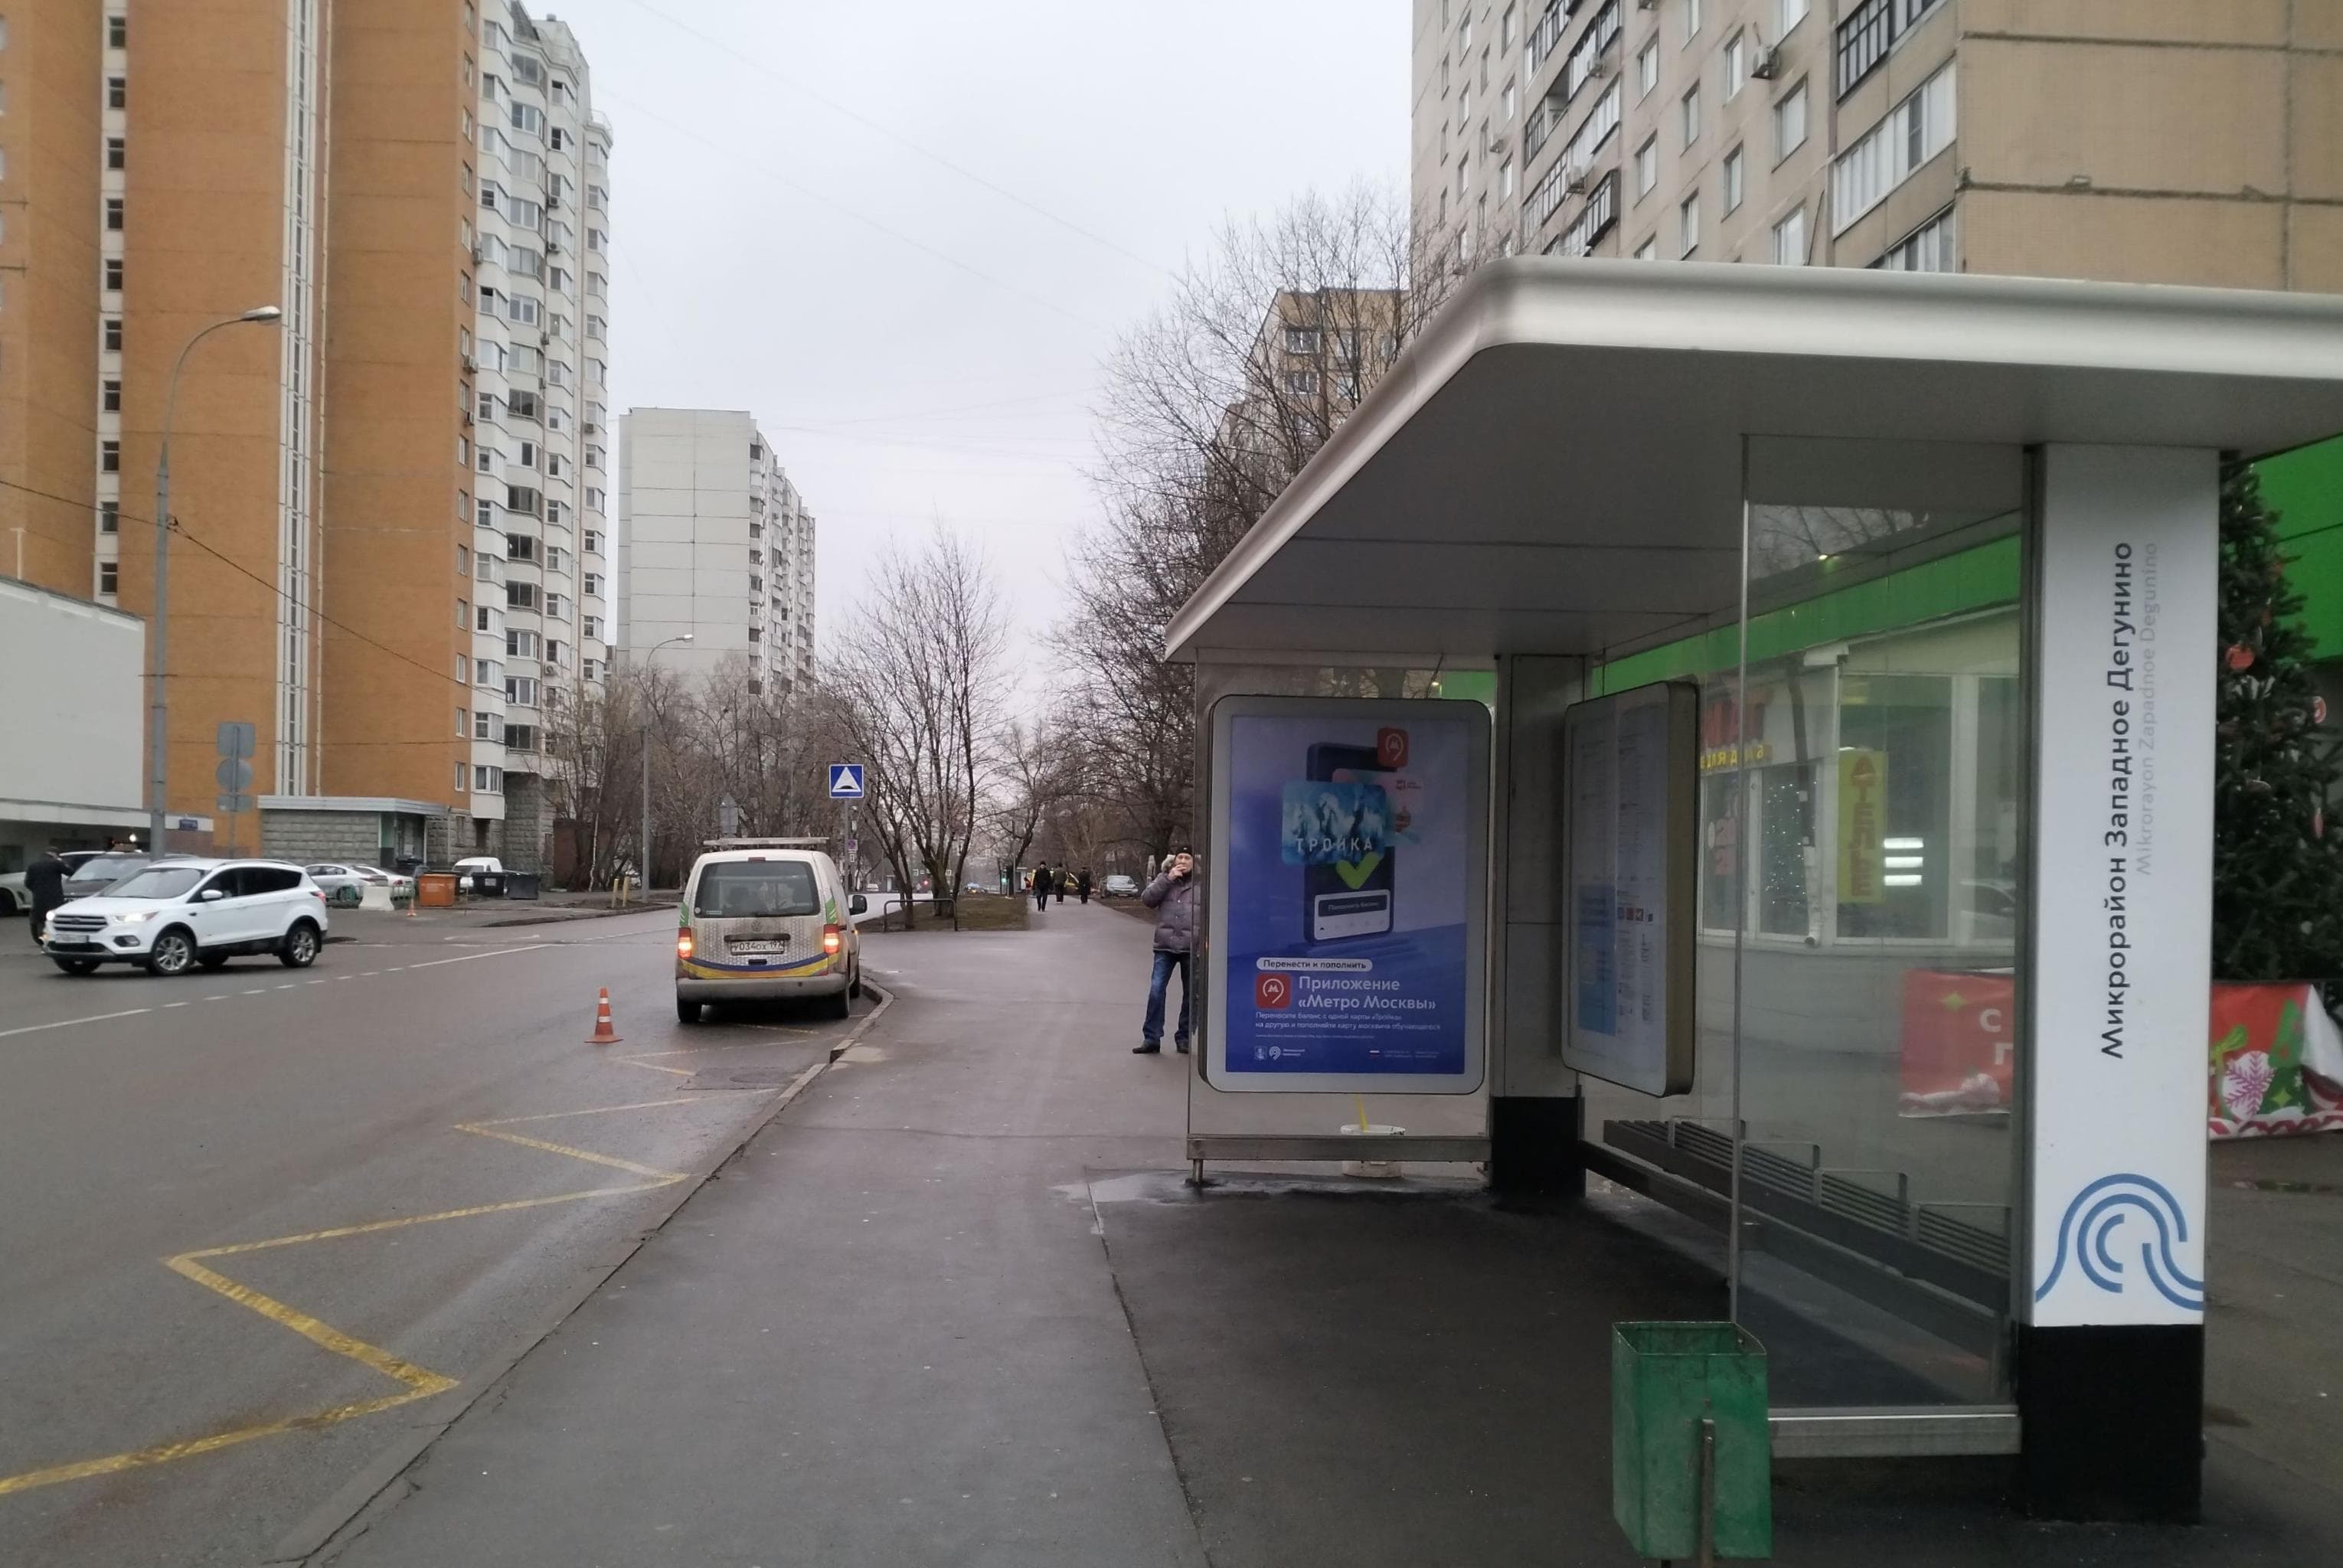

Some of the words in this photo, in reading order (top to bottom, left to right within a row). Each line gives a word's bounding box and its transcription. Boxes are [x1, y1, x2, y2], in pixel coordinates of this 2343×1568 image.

[2107, 541, 2135, 691] Дегунино
[2139, 543, 2159, 642] Degunino
[2138, 648, 2156, 750] Zapadnoe
[2104, 700, 2132, 847] Западное
[2135, 757, 2156, 875] Mikrorayon
[1263, 959, 1310, 969] Перенести
[1320, 962, 1367, 970] пополнить
[1299, 976, 1400, 992] Приложение
[1299, 995, 1360, 1011] «Метро
[1364, 995, 1436, 1010] Москвы»
[2101, 858, 2130, 1059] Микрорайон
[1979, 1008, 2002, 1033] С
